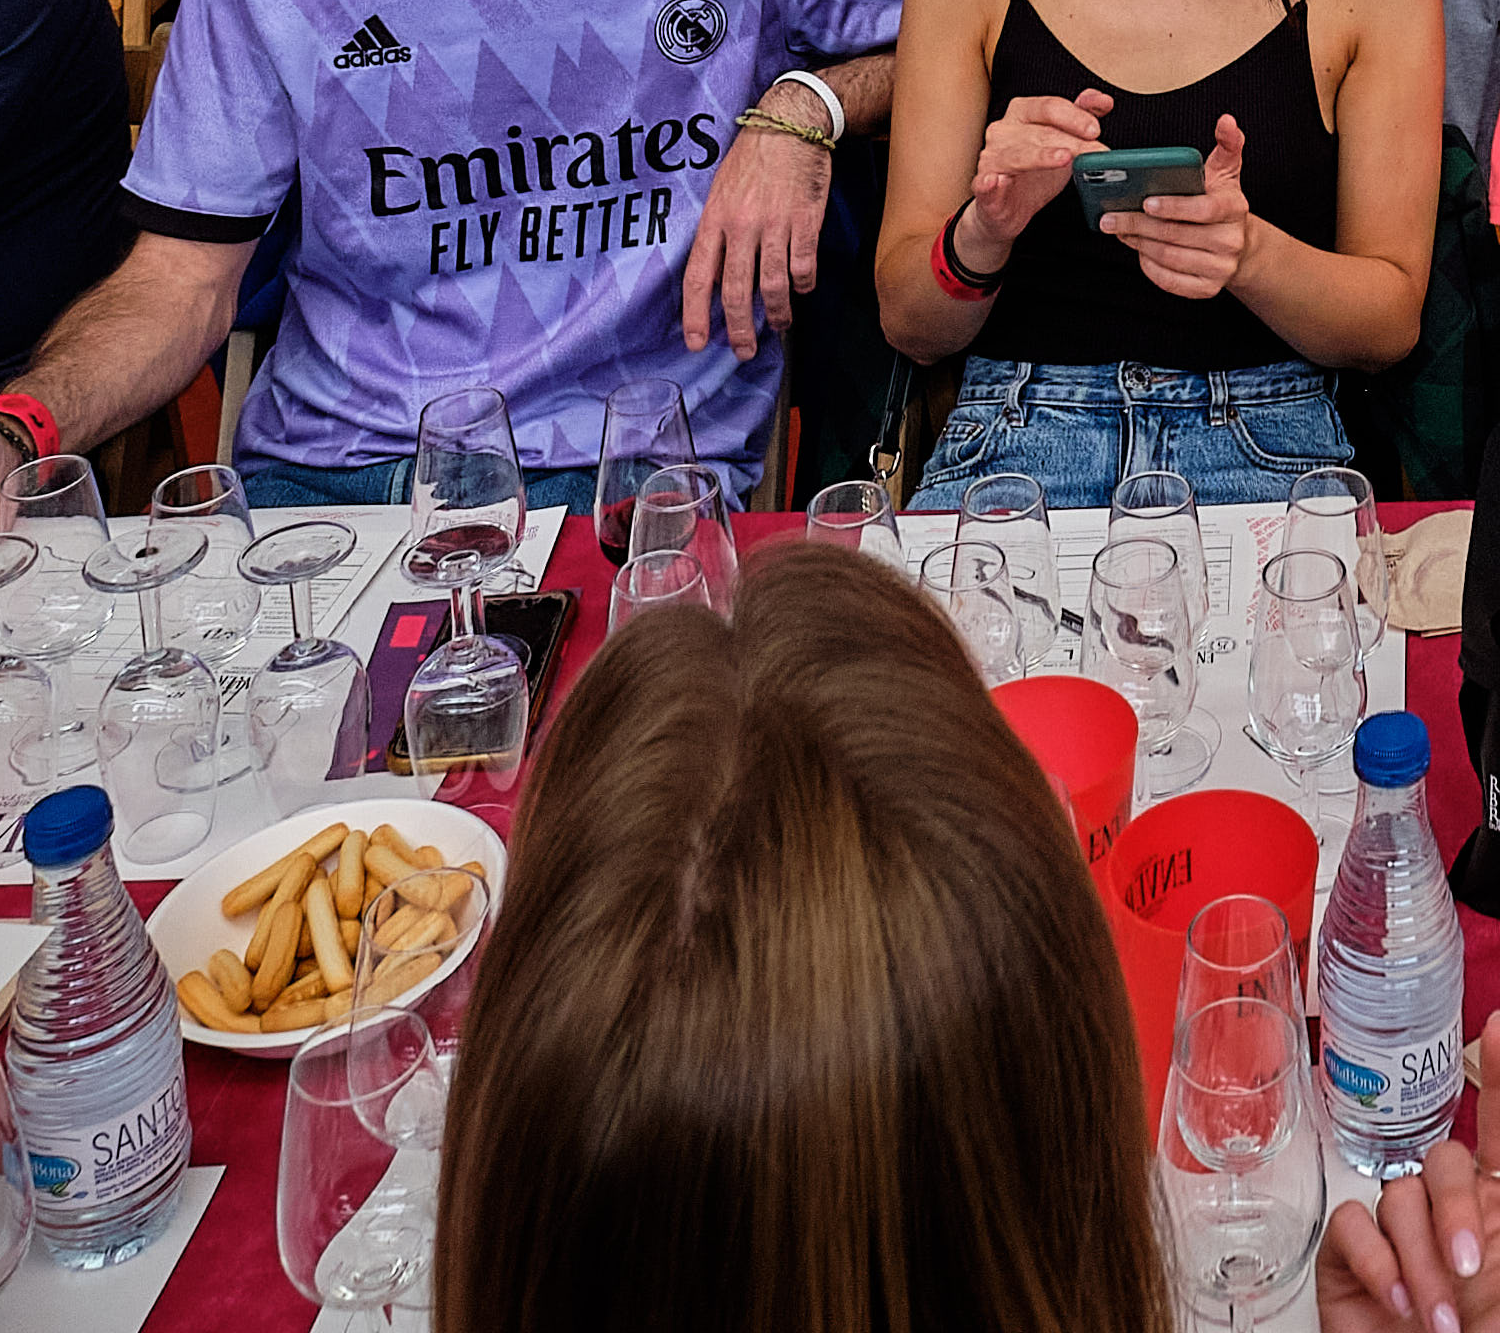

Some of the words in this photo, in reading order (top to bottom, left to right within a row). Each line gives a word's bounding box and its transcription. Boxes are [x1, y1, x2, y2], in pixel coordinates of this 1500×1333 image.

[333, 42, 412, 71] adidas
[363, 111, 723, 218] Emirates
[430, 216, 501, 275] FLY
[518, 186, 672, 264] BETTER
